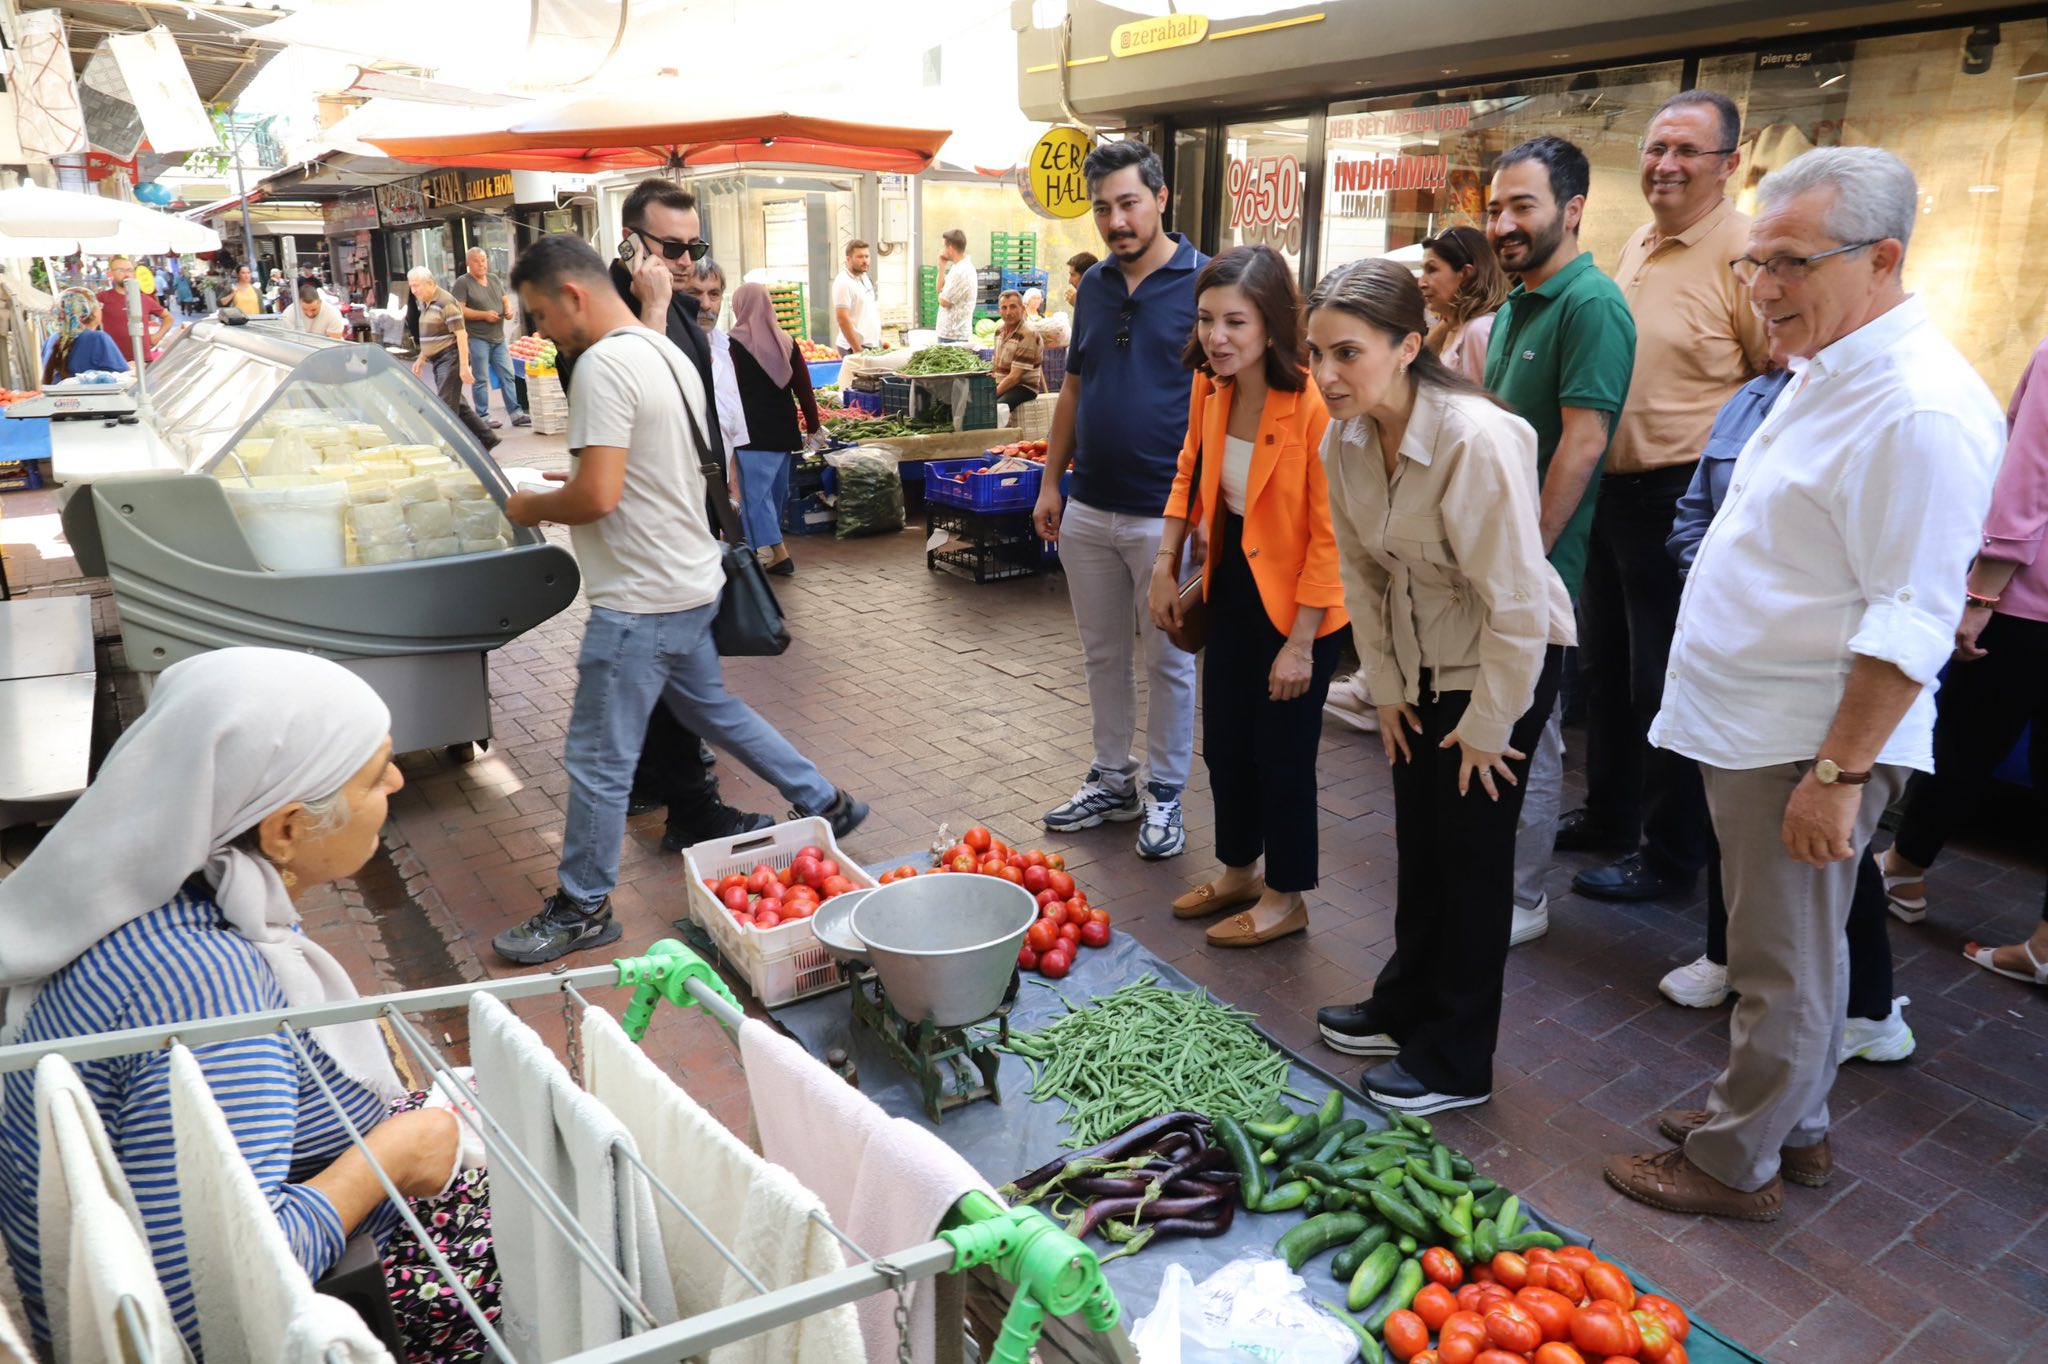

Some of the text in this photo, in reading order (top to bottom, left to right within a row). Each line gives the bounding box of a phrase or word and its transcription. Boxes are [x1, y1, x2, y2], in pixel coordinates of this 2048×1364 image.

[1760, 53, 1793, 66] pierre
[1329, 119, 1354, 139] HER
[1228, 155, 1299, 228] %50
